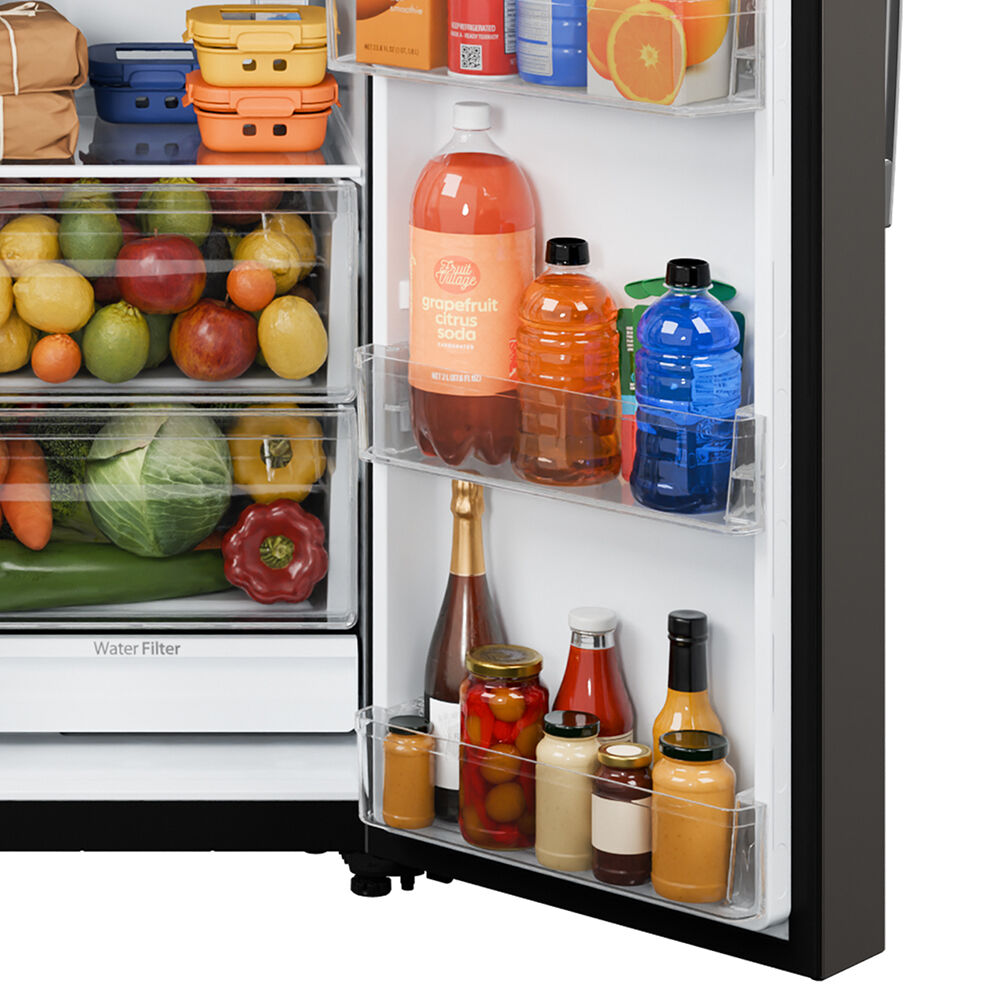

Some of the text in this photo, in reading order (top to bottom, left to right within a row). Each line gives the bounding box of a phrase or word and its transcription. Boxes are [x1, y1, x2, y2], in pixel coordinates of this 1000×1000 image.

[439, 258, 473, 277] Fruit
[435, 269, 478, 291] Village
[421, 296, 499, 313] grapefruit
[435, 311, 478, 327] citrus
[437, 326, 477, 342] soda
[93, 641, 181, 655] Water Filter
